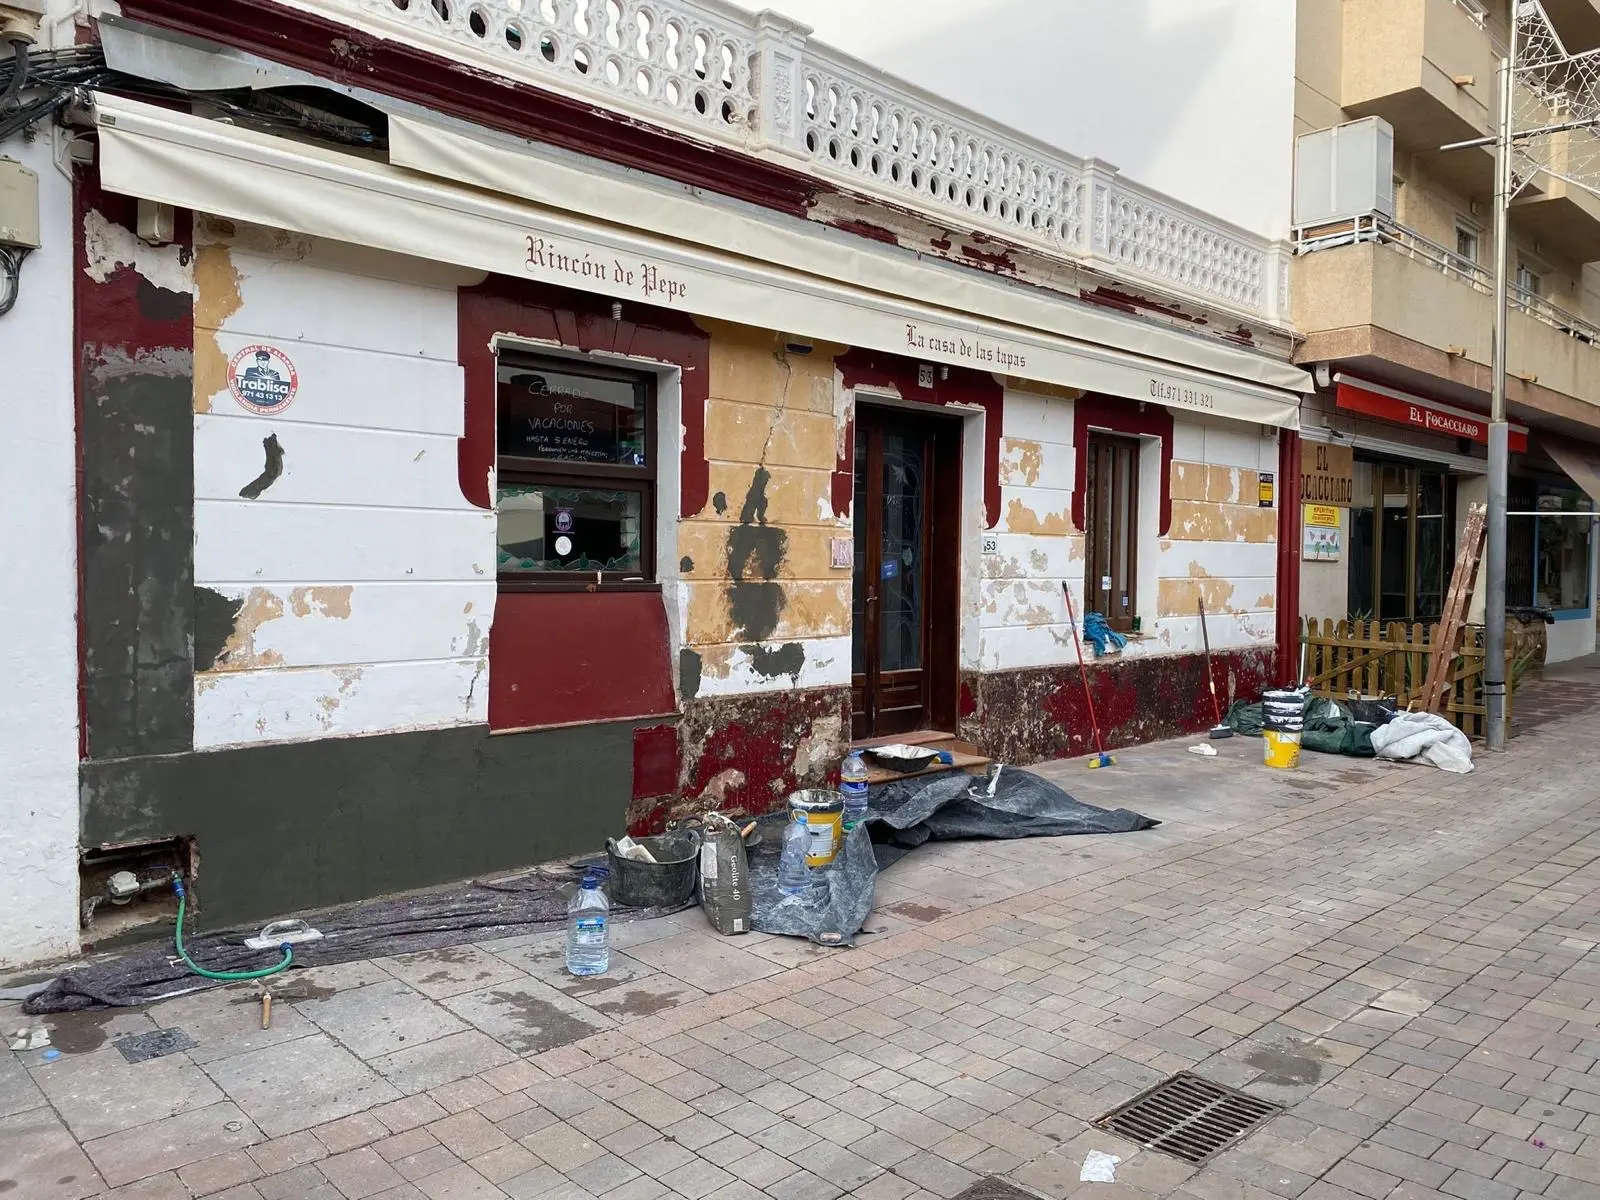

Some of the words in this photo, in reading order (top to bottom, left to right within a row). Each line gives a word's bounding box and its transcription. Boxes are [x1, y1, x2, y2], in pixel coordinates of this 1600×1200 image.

[525, 235, 606, 280] Rincón
[614, 260, 634, 286] de
[641, 263, 687, 302] Pepe
[906, 324, 925, 351] La
[929, 337, 956, 354] casa
[960, 339, 972, 357] de
[976, 341, 993, 361] las
[996, 346, 1026, 370] tapas
[236, 376, 289, 394] Trablisa
[919, 369, 932, 384] 53
[553, 402, 573, 414] POR
[1184, 390, 1198, 406] 331
[1200, 393, 1213, 408] 321
[528, 417, 594, 434] VACACIONES
[1409, 407, 1423, 422] EL
[1425, 410, 1478, 436] FOCACCIARO
[526, 435, 549, 443] HASTA
[562, 437, 589, 446] ENERO
[1316, 446, 1329, 471] EL
[1300, 474, 1353, 503] OCACCIARO
[986, 541, 996, 551] 53
[731, 855, 740, 887] Geolite
[733, 888, 741, 901] 40
